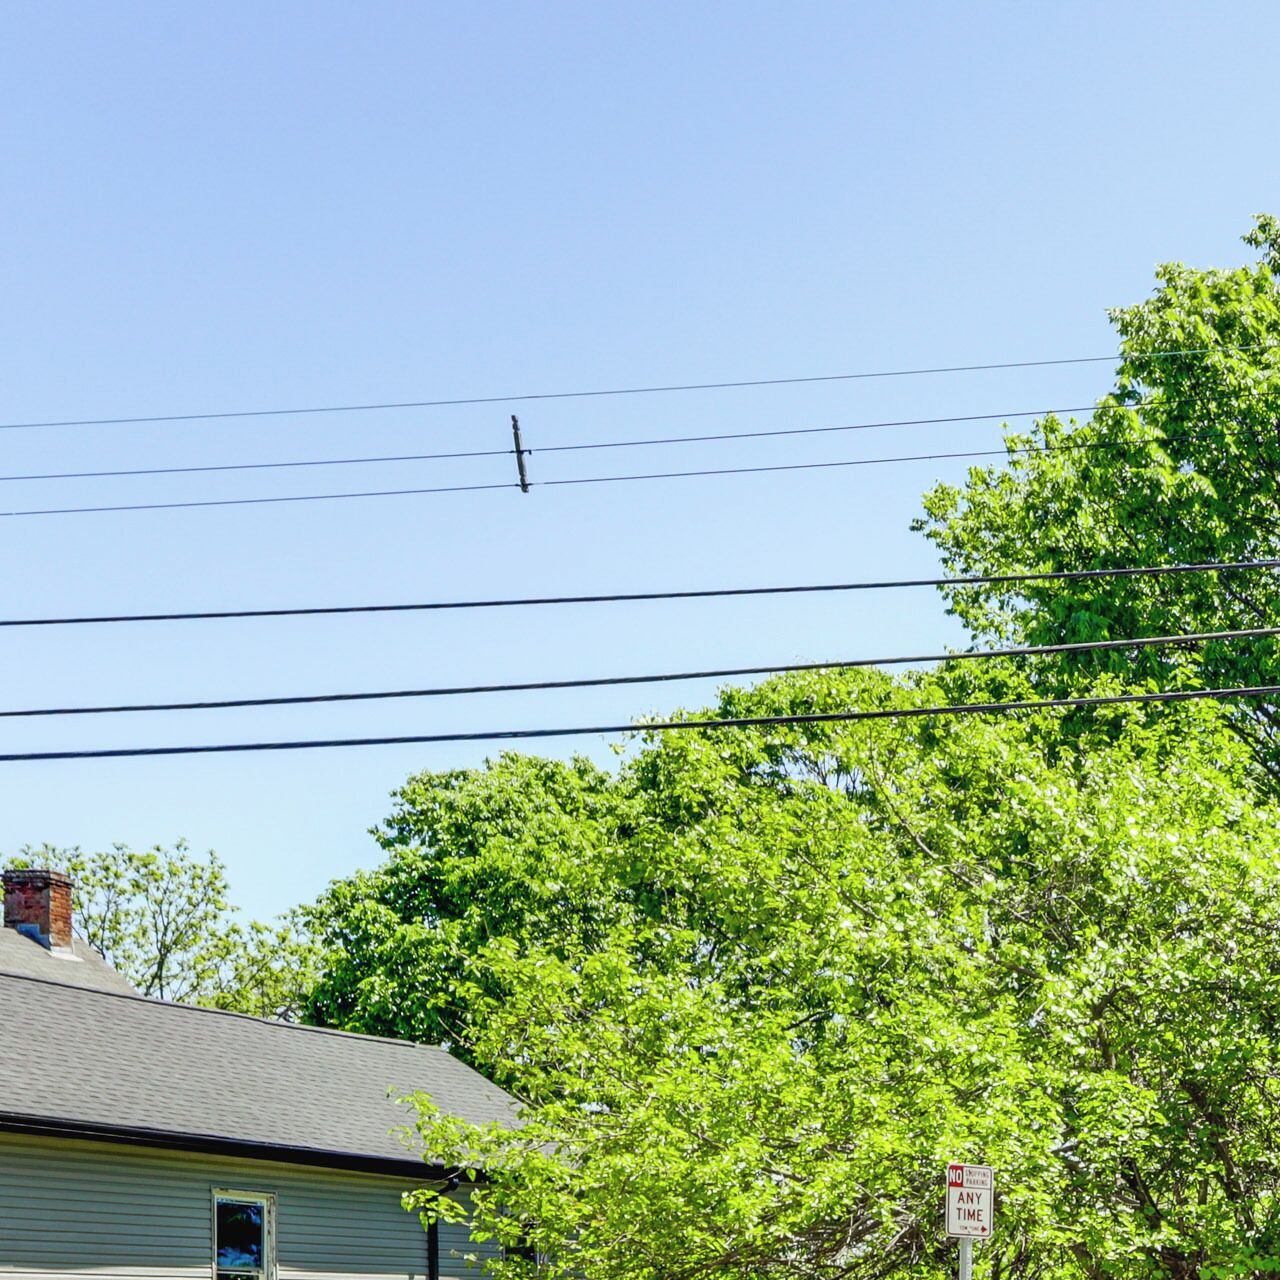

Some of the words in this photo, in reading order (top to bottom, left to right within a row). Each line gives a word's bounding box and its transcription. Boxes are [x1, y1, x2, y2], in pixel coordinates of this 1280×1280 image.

[949, 1169, 963, 1183] NO
[966, 1178, 988, 1186] PARKING
[957, 1192, 982, 1205] ANY
[956, 1208, 983, 1222] TIME
